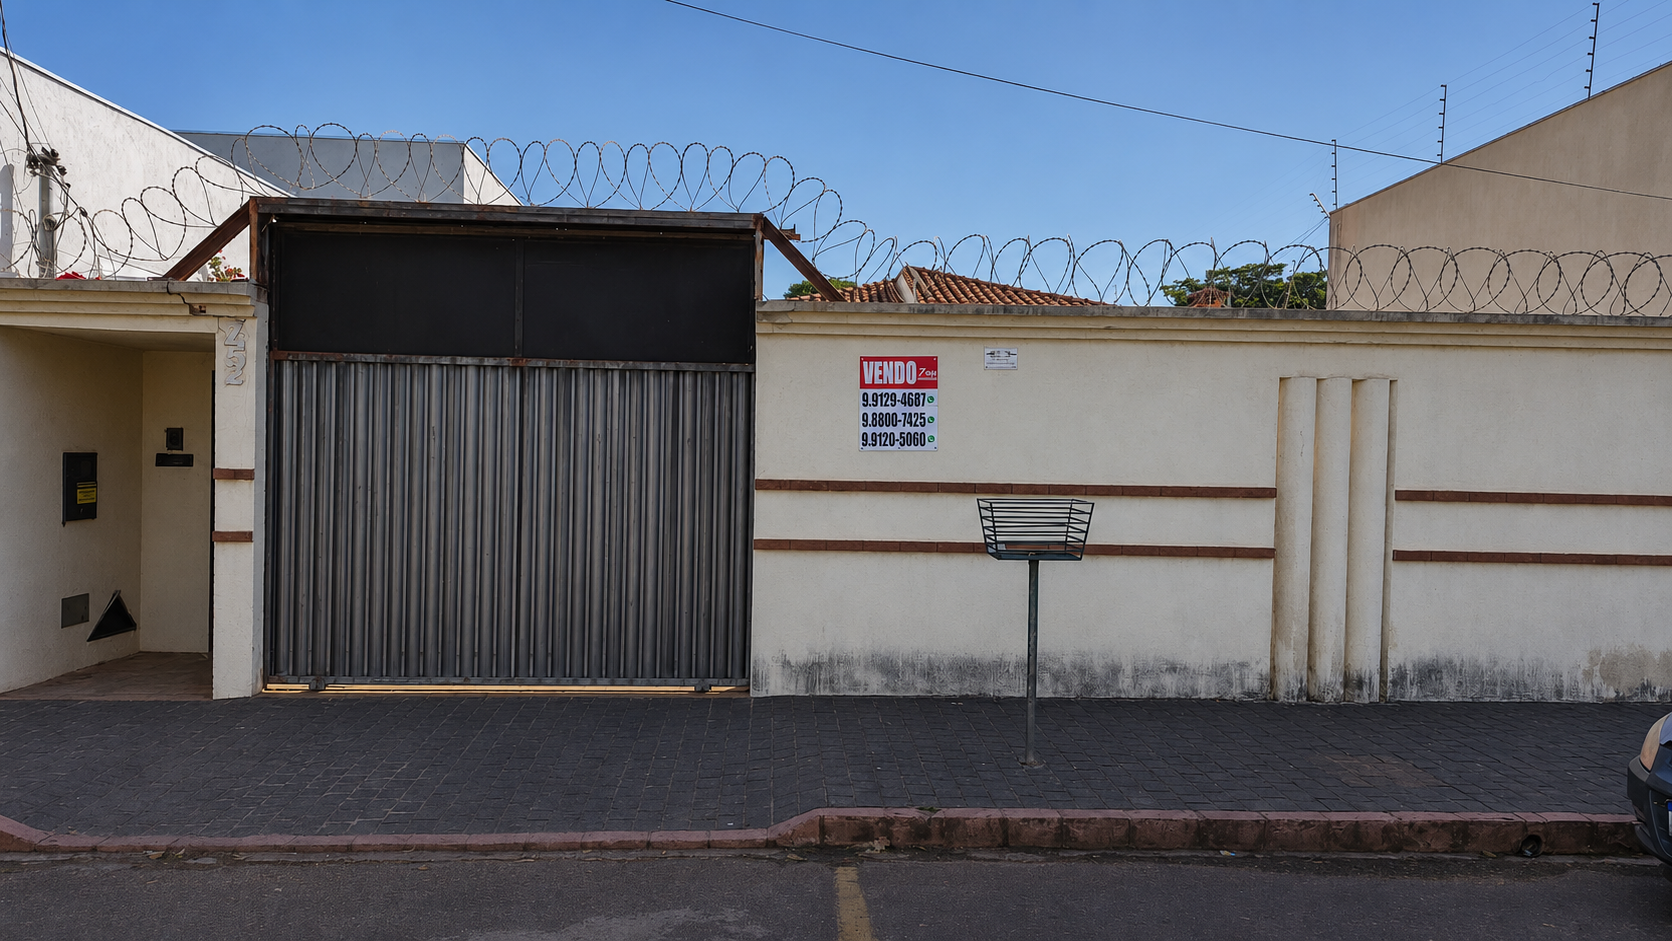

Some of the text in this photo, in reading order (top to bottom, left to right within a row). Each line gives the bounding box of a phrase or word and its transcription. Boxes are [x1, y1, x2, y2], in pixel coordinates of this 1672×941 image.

[863, 361, 917, 385] VENDO
[862, 392, 926, 408] 9.9129-4687
[862, 412, 927, 428] 9.8800-7425
[861, 432, 926, 447] 9.9120-5060
